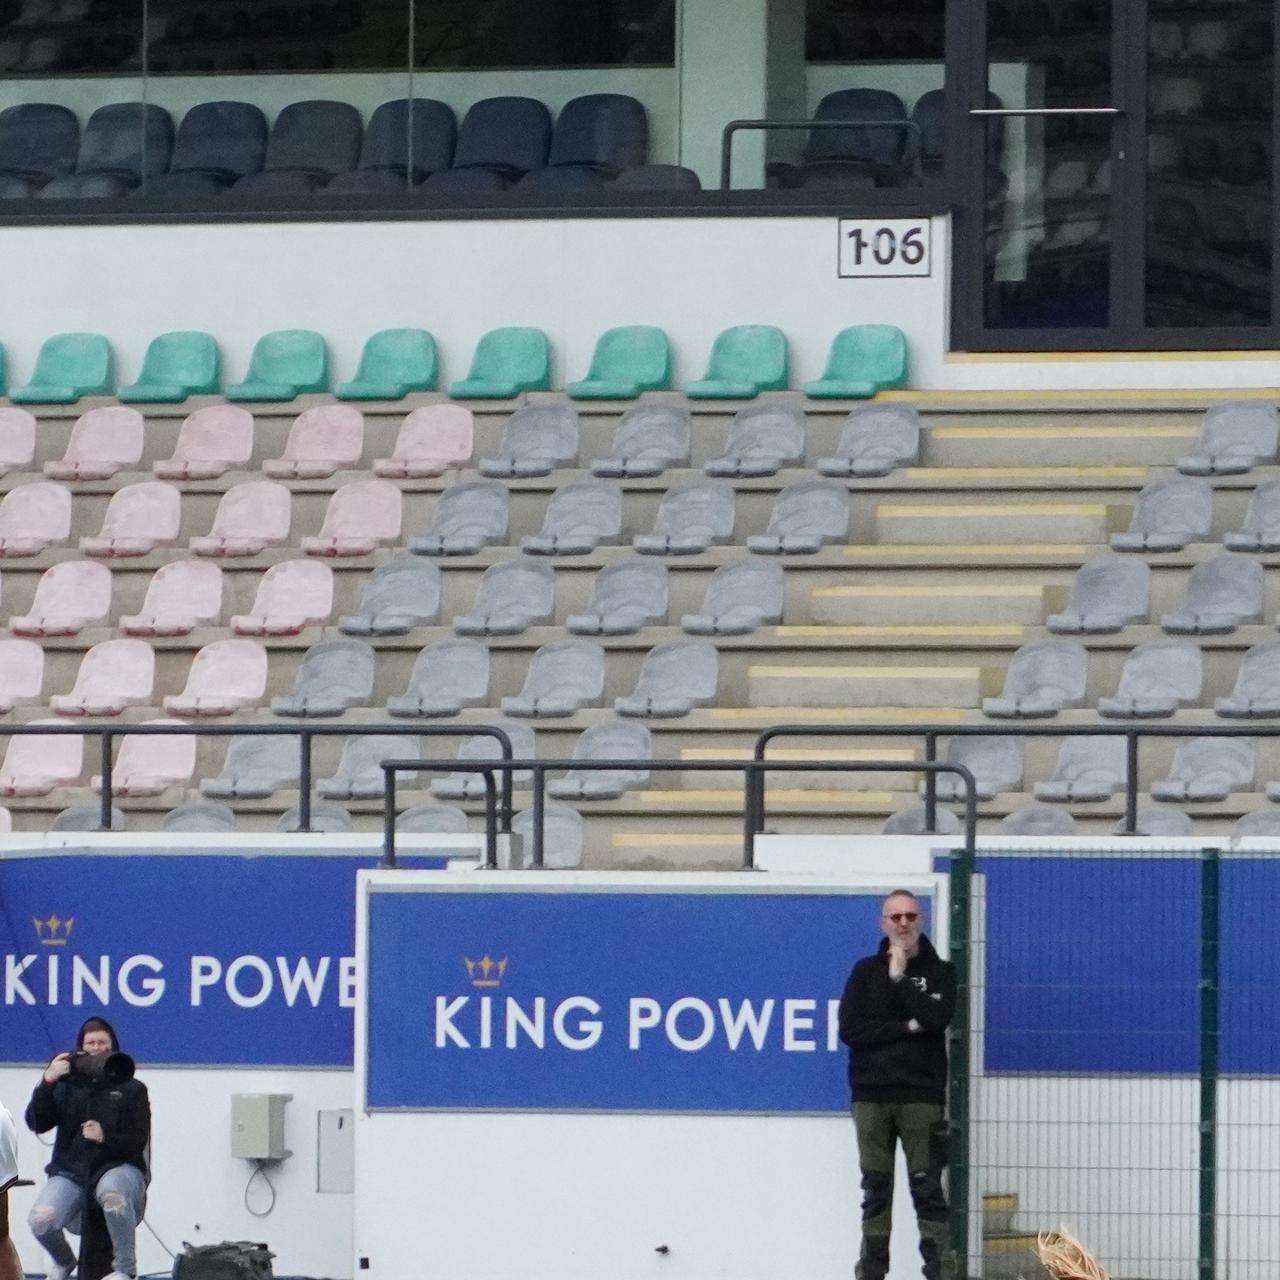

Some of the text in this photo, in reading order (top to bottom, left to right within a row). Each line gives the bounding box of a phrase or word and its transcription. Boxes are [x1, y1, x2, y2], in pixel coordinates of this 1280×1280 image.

[847, 227, 924, 265] 106
[5, 954, 166, 1008] KING
[435, 995, 604, 1051] KING
